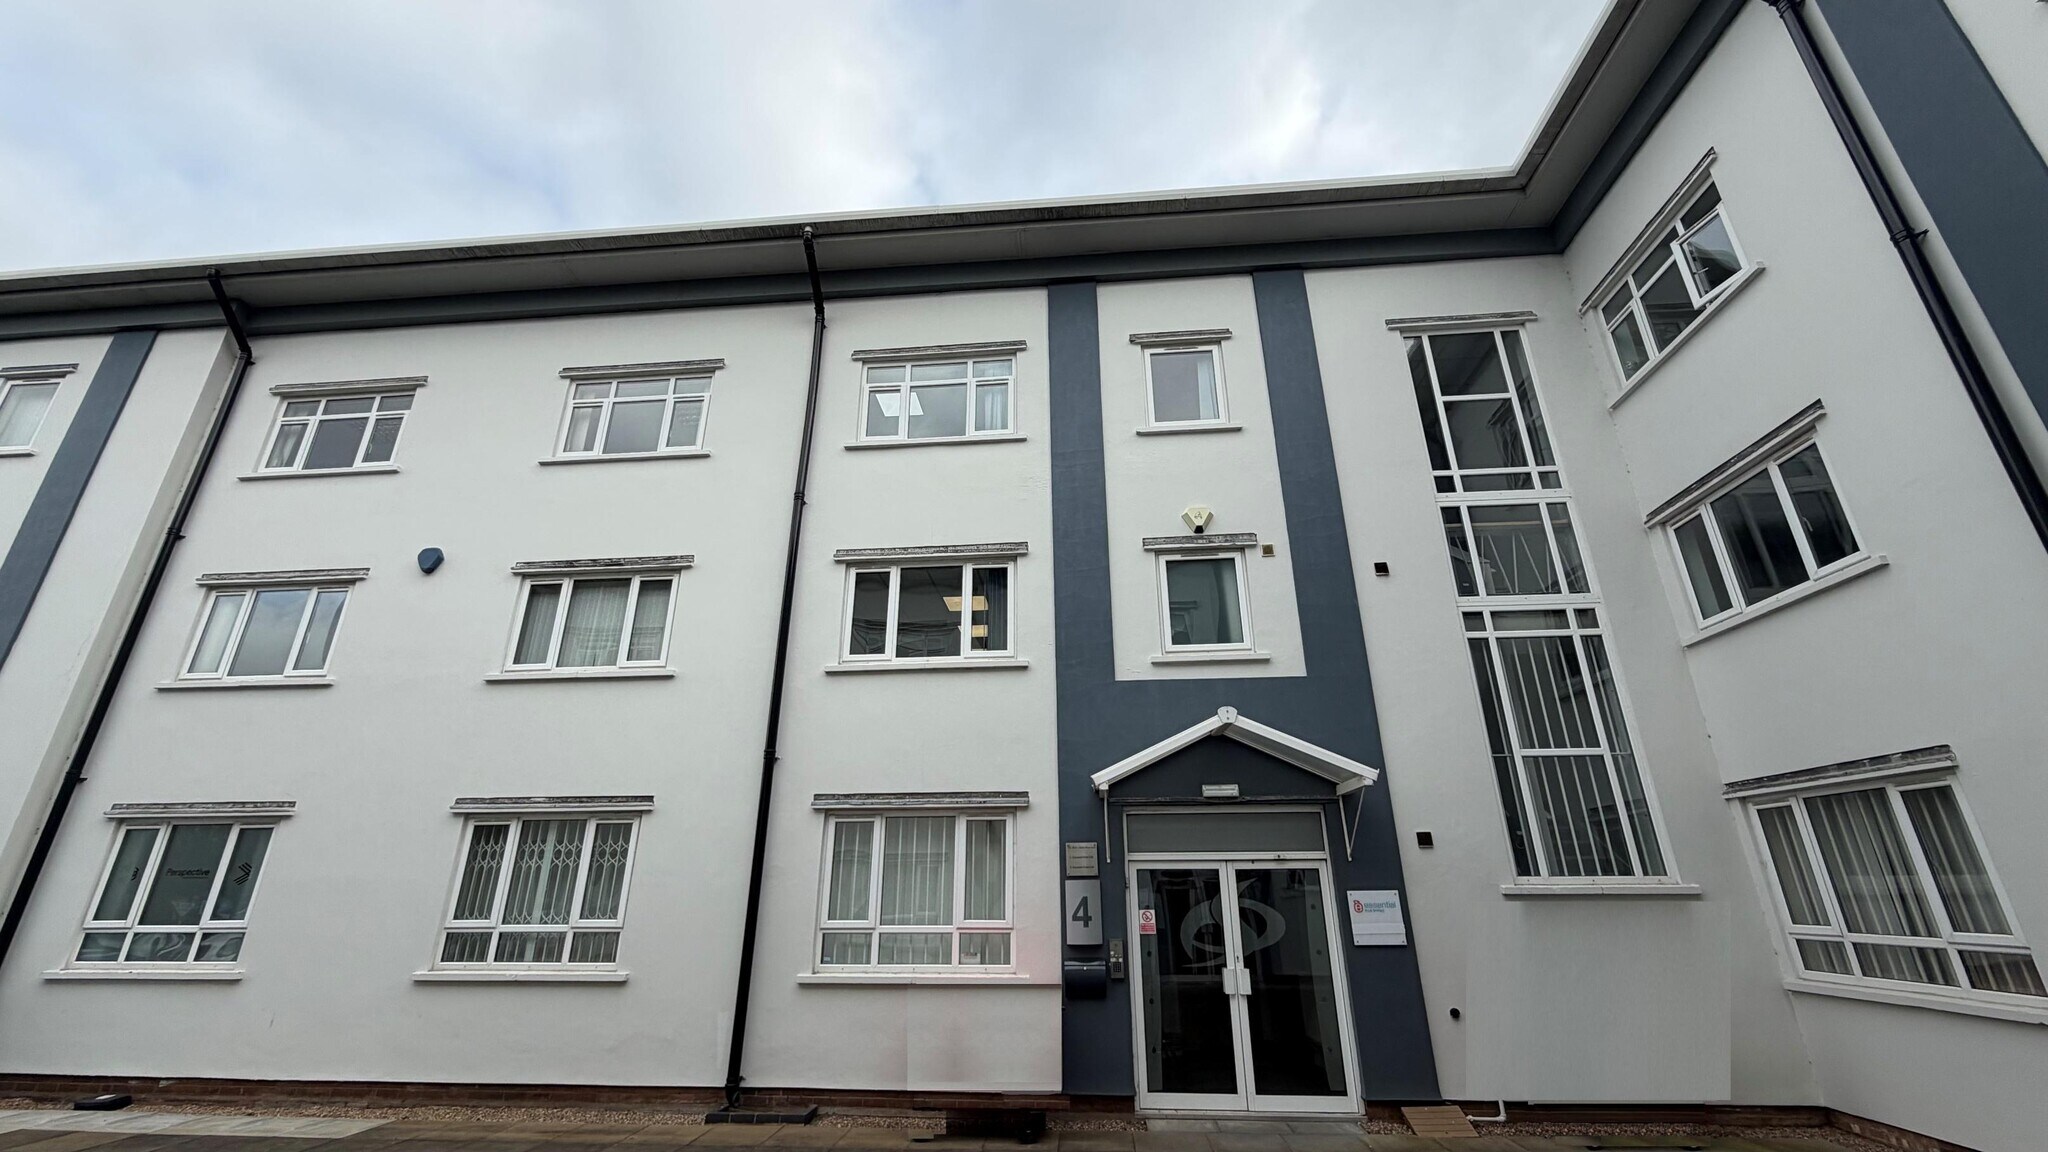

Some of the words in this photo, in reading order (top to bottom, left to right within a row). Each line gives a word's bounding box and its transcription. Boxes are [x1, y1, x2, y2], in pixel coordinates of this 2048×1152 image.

[165, 867, 210, 877] Perspective
[1364, 901, 1396, 909] essential
[1072, 896, 1092, 928] 4
